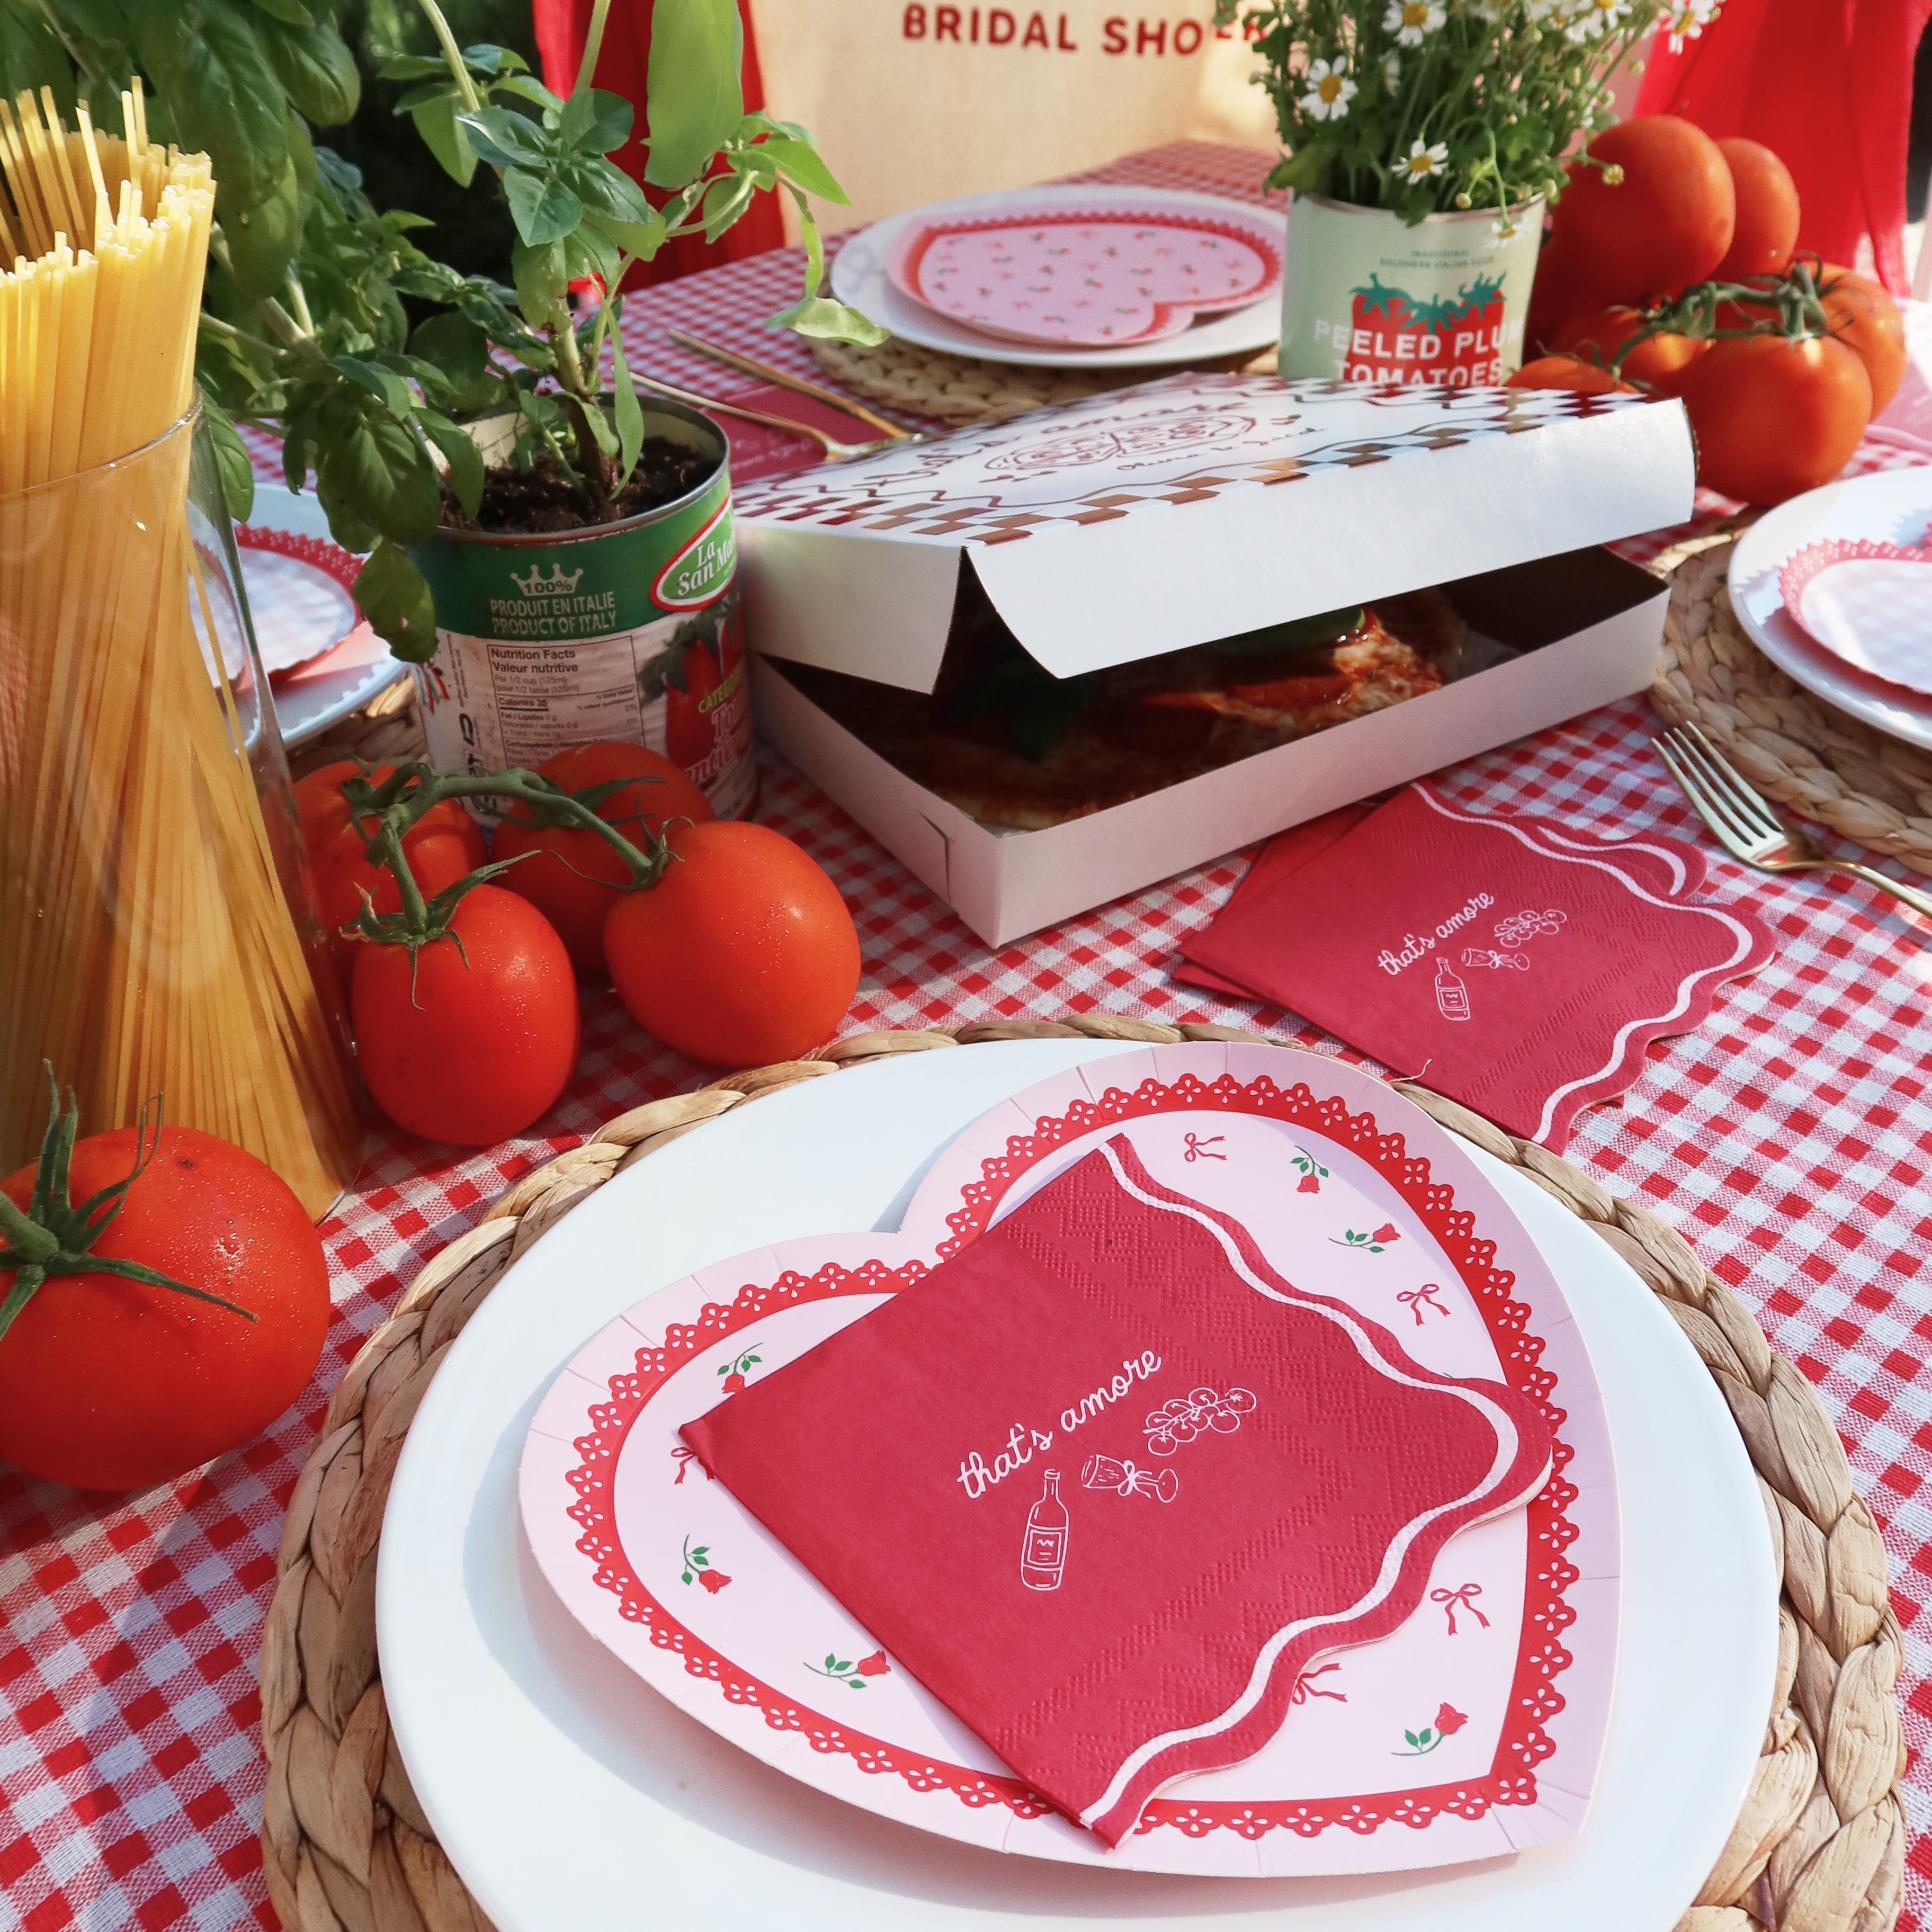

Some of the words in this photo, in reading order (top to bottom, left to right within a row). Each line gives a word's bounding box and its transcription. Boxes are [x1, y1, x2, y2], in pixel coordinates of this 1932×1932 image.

[902, 3, 1077, 52] BRIDAL
[1102, 8, 1265, 55] SHO
[1314, 319, 1442, 361] PEELED
[1336, 356, 1503, 387] TOMATOES
[696, 541, 715, 568] La
[524, 579, 573, 594] 100%
[678, 561, 714, 596] San
[490, 598, 549, 617] PRODUIT
[552, 598, 570, 615] EN
[573, 591, 616, 613] ITALIE
[491, 617, 554, 635] PRODUCT
[558, 616, 576, 633] OF
[579, 610, 616, 632] ITALY
[490, 648, 540, 660] Nutrition
[543, 649, 576, 659] Facts
[493, 662, 528, 673] Valeur
[531, 663, 578, 673] nutritive
[498, 697, 535, 707] Calories
[1378, 933, 1436, 976] that's
[1436, 891, 1495, 939] amore
[956, 1423, 1054, 1499] that's
[1060, 1349, 1162, 1433] amore
